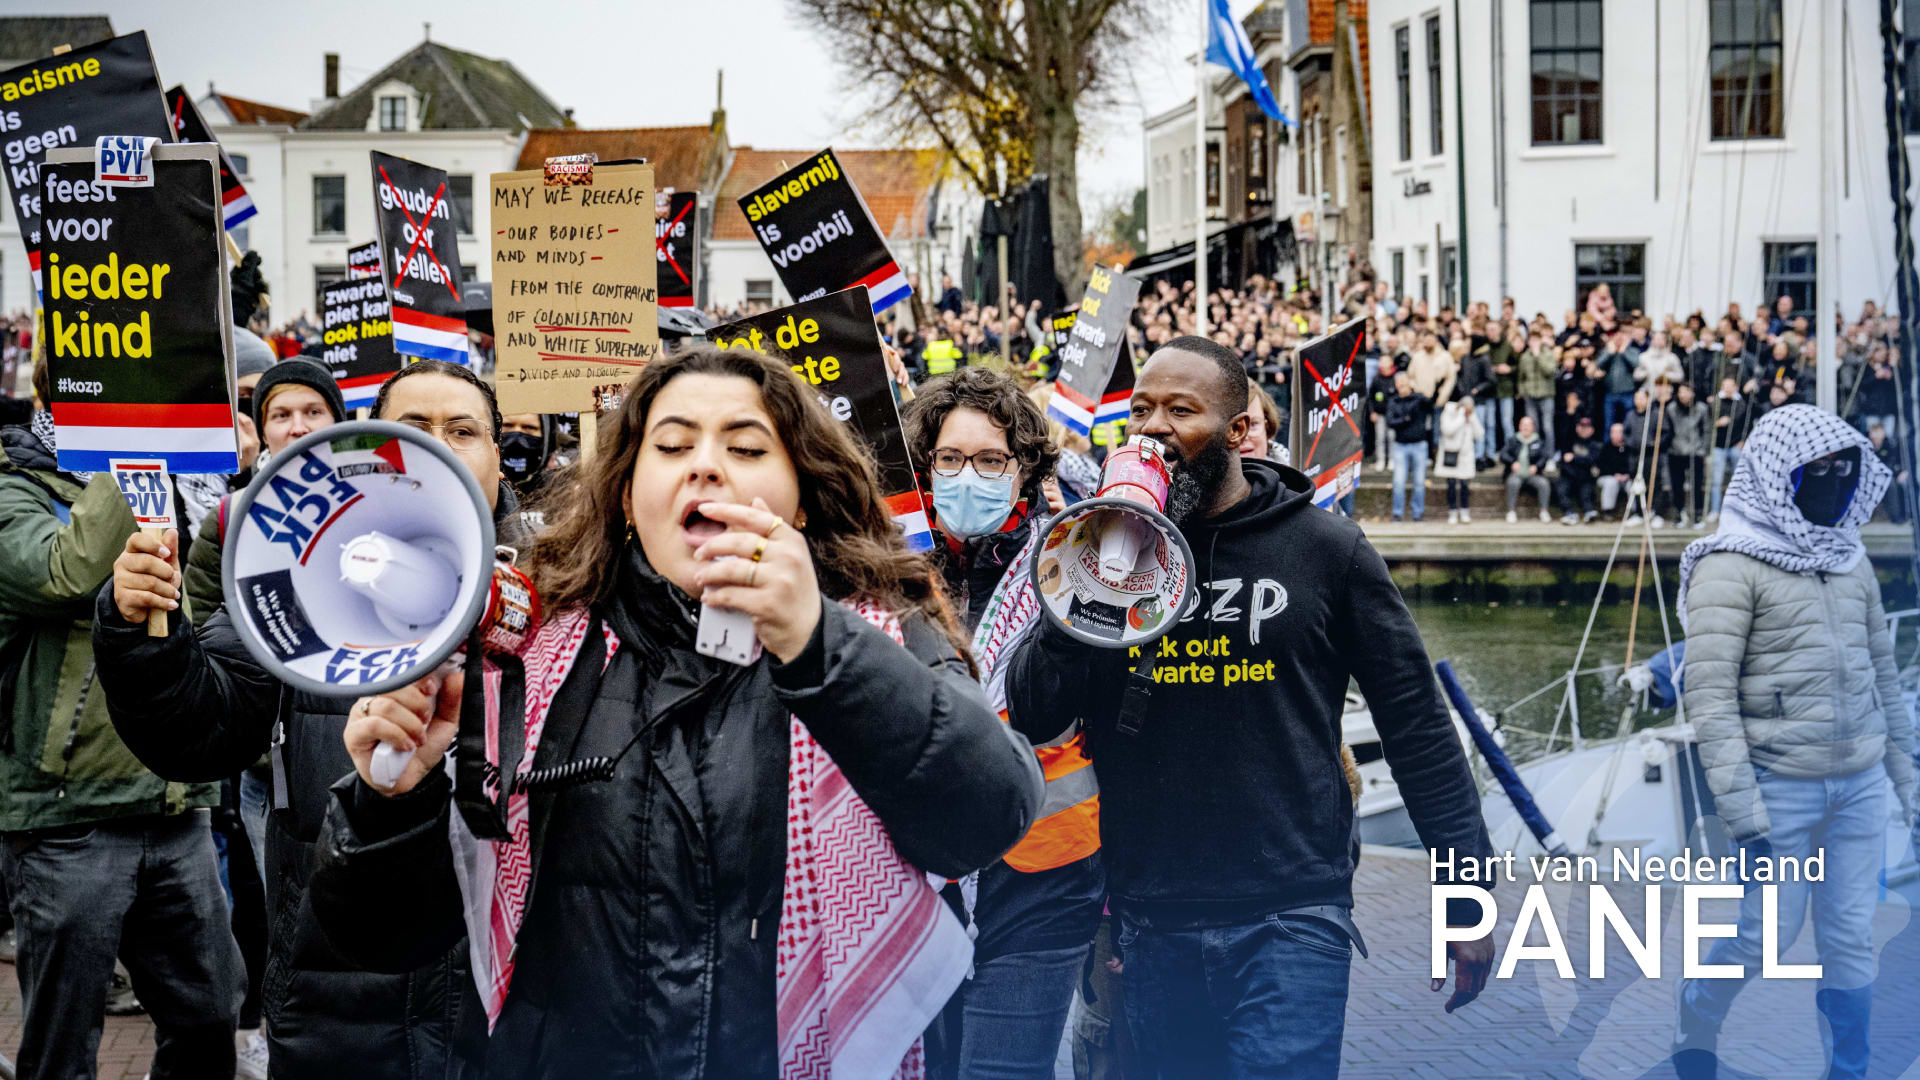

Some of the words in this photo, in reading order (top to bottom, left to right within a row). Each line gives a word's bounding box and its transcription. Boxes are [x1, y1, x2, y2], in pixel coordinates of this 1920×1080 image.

[0, 57, 101, 102] acisme
[5, 124, 77, 164] geen
[551, 165, 587, 173] RACISME
[45, 173, 117, 203] feest
[495, 186, 534, 208] MAY
[544, 186, 572, 204] WE
[582, 187, 645, 207] RELEASE
[747, 154, 839, 221] slavernij
[380, 182, 450, 220] gouden
[46, 217, 112, 242] voor
[757, 223, 781, 246] is
[772, 210, 854, 268] voorbij
[394, 247, 452, 285] bellen
[497, 249, 526, 263] AND
[49, 252, 171, 300] ieder
[511, 279, 548, 296] FROM
[555, 281, 583, 295] THE
[1090, 267, 1112, 295] kick
[326, 282, 384, 306] zwarte
[325, 304, 359, 328] piet
[507, 311, 525, 323] OF
[533, 309, 633, 326] COLONISATION
[1082, 296, 1101, 318] out
[52, 310, 152, 358] kind
[324, 323, 358, 345] ook
[776, 315, 819, 350] de
[1072, 319, 1106, 348] zwarte
[324, 344, 357, 364] niet
[507, 332, 536, 347] AND
[544, 335, 590, 354] WHITE
[595, 338, 658, 359] SUPREMACY
[1063, 342, 1087, 367] piet
[562, 368, 580, 378] AND
[1315, 364, 1353, 401] rode
[57, 378, 103, 395] #kozp
[1308, 392, 1359, 435] lippen
[117, 472, 167, 492] FCK
[248, 449, 334, 541] PVV
[270, 472, 359, 560] FCK
[252, 584, 262, 597] to
[1120, 582, 1155, 592] AGAIN
[1168, 574, 1179, 595] PIET
[1169, 562, 1187, 609] RACISME
[256, 596, 273, 620] fight
[267, 589, 281, 610] We
[275, 610, 302, 647] Promise
[1080, 607, 1091, 617] We
[1092, 611, 1118, 625] Promise
[1079, 616, 1094, 626] fight
[1094, 621, 1120, 632] injustice
[329, 644, 420, 667] FCK
[1186, 635, 1230, 657] out
[1129, 662, 1215, 684] warte
[1224, 659, 1275, 687] piet
